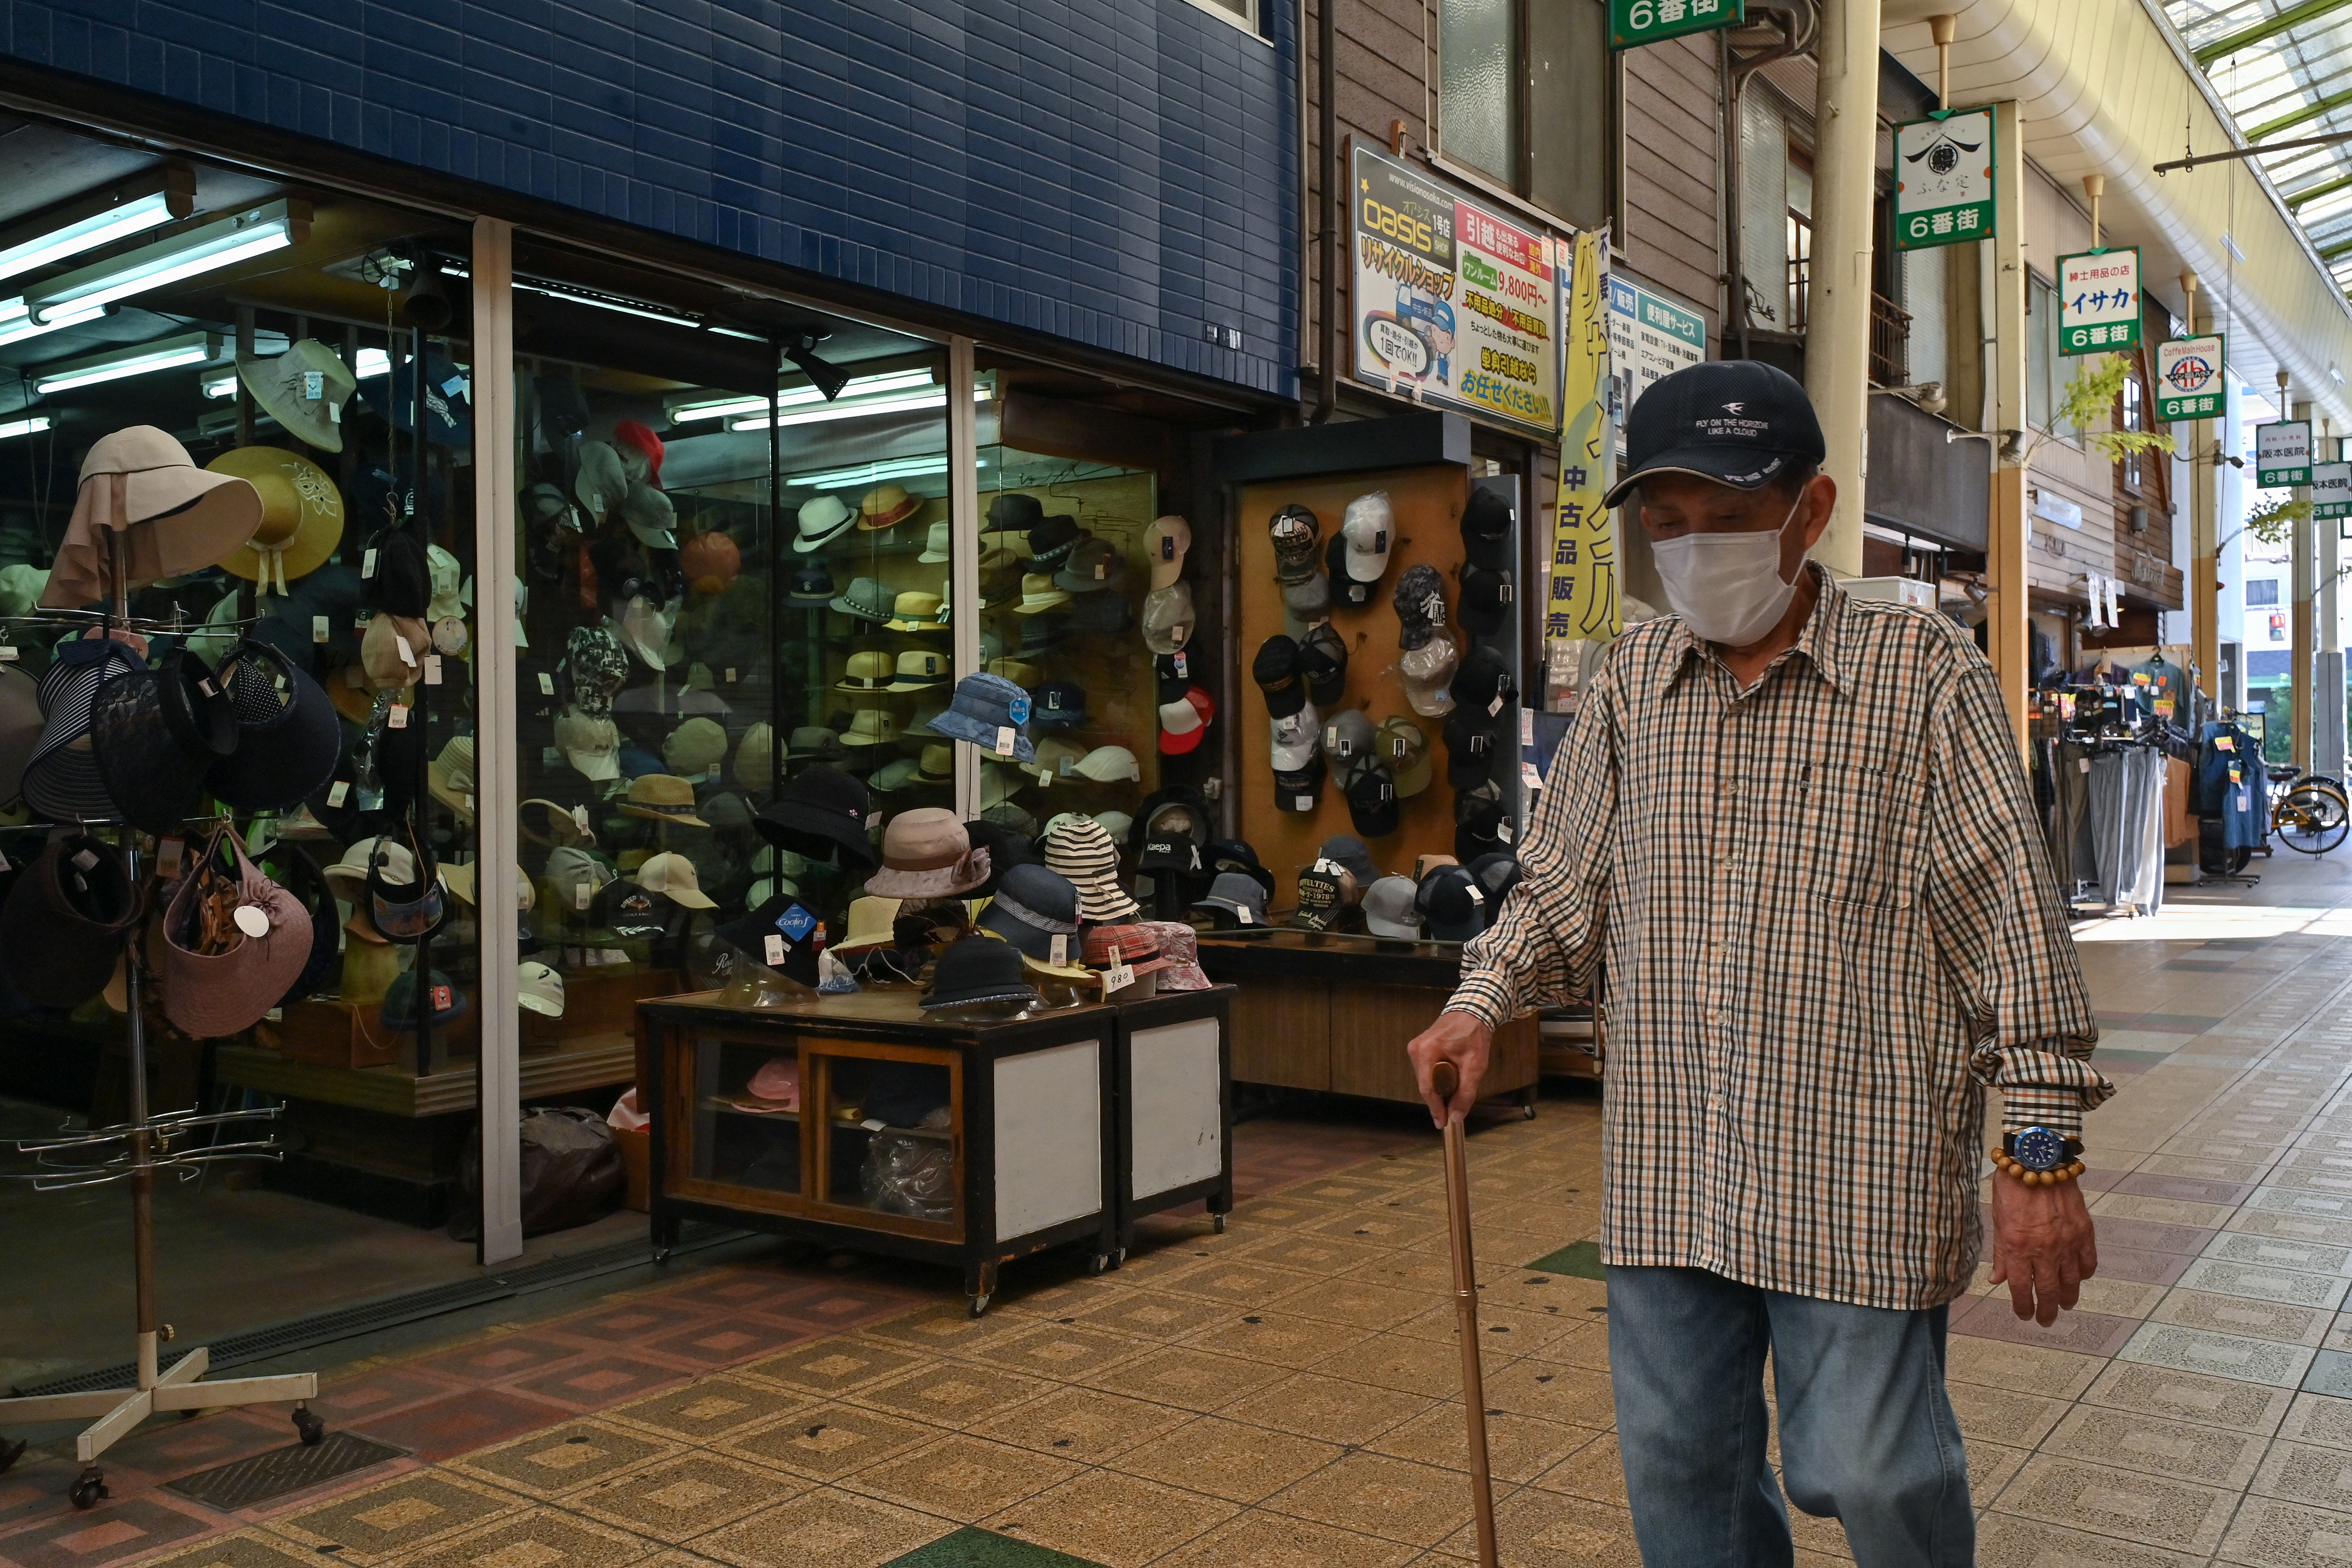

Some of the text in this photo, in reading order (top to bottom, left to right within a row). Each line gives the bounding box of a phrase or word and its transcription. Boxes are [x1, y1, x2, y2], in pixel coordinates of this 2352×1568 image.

[1630, 0, 1718, 29] 6番街
[1389, 173, 1453, 211] www.visionosaka.com
[1403, 200, 1431, 224] オアシス
[1910, 209, 1979, 238] 6番街
[1433, 214, 1450, 238] 1号店
[1467, 212, 1495, 252] 引越
[1496, 228, 1519, 248] も出来る
[1435, 240, 1448, 253] SHOP
[1496, 241, 1526, 266] 便利なお店
[1529, 243, 1541, 262] 国内
[1361, 235, 1456, 301] リサイクルショップ
[1464, 262, 1497, 287] ワンルーム
[1529, 260, 1542, 276] 海外
[2069, 265, 2130, 282] 紳士用品の店
[2071, 288, 2129, 315] イサカ
[1647, 302, 1695, 338] 便利屋サービス
[1470, 320, 1539, 355] ちょっとした物も大事に運びます
[2072, 325, 2128, 346] 6番街
[1481, 346, 1537, 386] 単身引越なら
[1460, 370, 1552, 420] お任せください!!
[2167, 397, 2214, 415] 6番街
[1696, 419, 1709, 428] FLY
[1738, 419, 1769, 429] HORIZON
[1733, 427, 1757, 437] CLOUD
[2265, 470, 2303, 483] 6番街
[2312, 504, 2346, 516] 6番街
[1546, 465, 1587, 638] 中古品販売
[1146, 843, 1171, 853] Kaepa
[621, 895, 637, 909] SPEED
